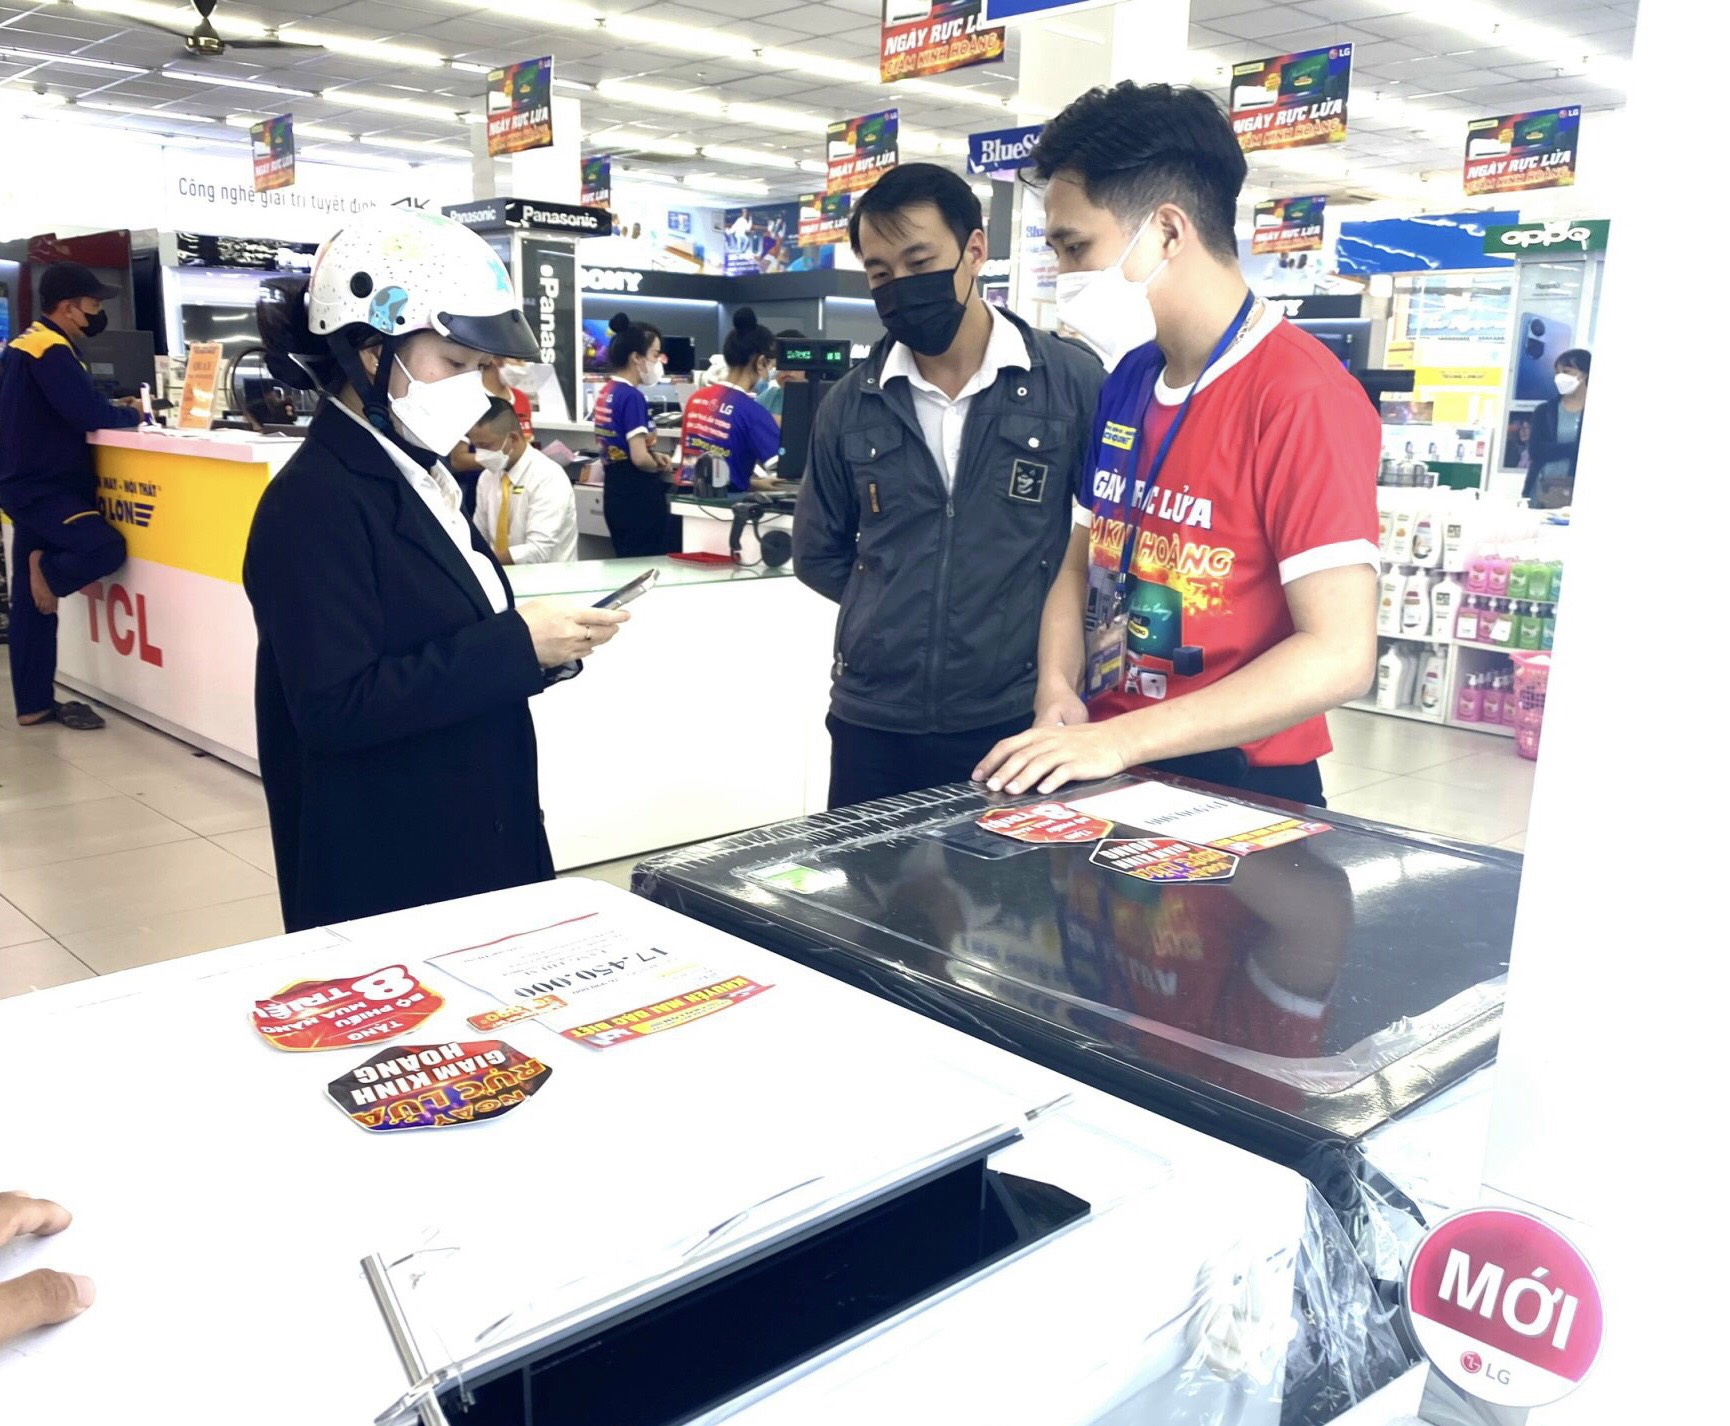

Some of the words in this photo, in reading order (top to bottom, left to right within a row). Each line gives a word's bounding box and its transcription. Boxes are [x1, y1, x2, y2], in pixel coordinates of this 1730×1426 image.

[884, 27, 928, 56] NGÀY
[929, 21, 963, 45] RỰC
[950, 31, 998, 57] HOÀNG
[1339, 47, 1351, 57] LG
[1233, 112, 1275, 134] NGÀY
[1275, 105, 1308, 127] RỰC
[1309, 97, 1343, 119] LỬA
[1568, 109, 1579, 117] LG
[981, 133, 1040, 164] BlueS
[1466, 160, 1507, 180] NGÀY
[1508, 155, 1540, 173] RỰC
[1540, 148, 1571, 167] LỬA
[178, 178, 215, 203] Công
[221, 183, 255, 206] nghệ
[450, 205, 497, 224] Panasonic
[522, 205, 598, 229] Panasonic
[719, 402, 734, 416] LG
[1092, 467, 1127, 504] GÀY
[1158, 484, 1212, 529] LỬA
[1138, 531, 1235, 577] HOÀNG
[79, 581, 163, 668] TCL
[351, 967, 415, 1001] 8
[514, 947, 668, 997] 17.450.000
[318, 1001, 368, 1019] MUA
[334, 1004, 394, 1028] PHIẾU
[394, 992, 425, 1008] BỘ
[346, 1020, 404, 1041] TẶNG
[351, 1041, 465, 1084] HOÀNG
[430, 1049, 507, 1081] GIẢM
[452, 1057, 546, 1100] RỰC
[350, 1071, 433, 1105] KINH
[349, 1088, 449, 1128] LỬA
[430, 1089, 527, 1127] NGÀY
[1438, 1248, 1578, 1351] MỚI
[1485, 1363, 1511, 1385] LG
